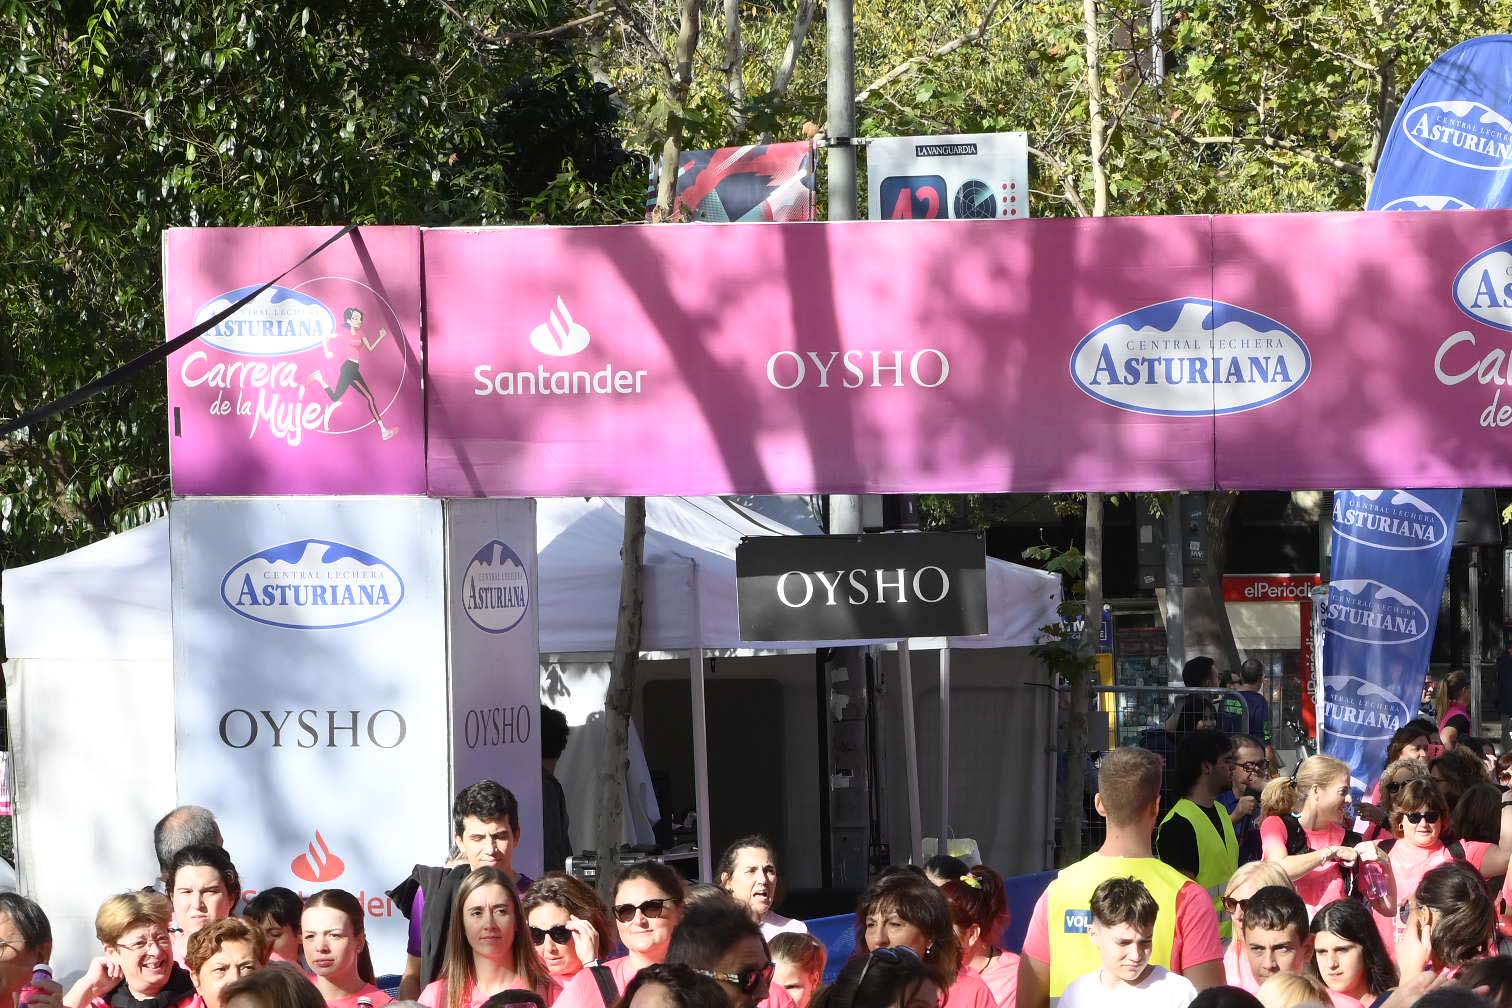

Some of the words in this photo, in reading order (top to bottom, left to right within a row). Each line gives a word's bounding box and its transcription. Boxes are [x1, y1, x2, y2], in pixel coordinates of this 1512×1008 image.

[1126, 338, 1201, 351] CENTRAL
[1208, 337, 1284, 350] LECHERA
[180, 350, 299, 389] Carrera
[473, 364, 648, 395] Santander
[766, 348, 951, 390] OYSHO
[1088, 342, 1293, 386] ASTURIANA
[209, 390, 232, 416] de
[236, 387, 252, 416] la
[249, 380, 343, 447] Mujer
[1332, 497, 1436, 542] ASTURIANA
[235, 572, 391, 607] ASTURIANA
[263, 570, 321, 580] CENTRAL
[327, 570, 385, 580] LECHERA
[467, 574, 526, 611] ASTURIANA
[776, 565, 951, 608] OYSHO
[1244, 581, 1312, 599] elPeriódi
[1327, 602, 1419, 636] STURIANA
[219, 709, 407, 749] OYSHO
[464, 704, 531, 749] OYSHO
[1325, 701, 1401, 731] TURIANA
